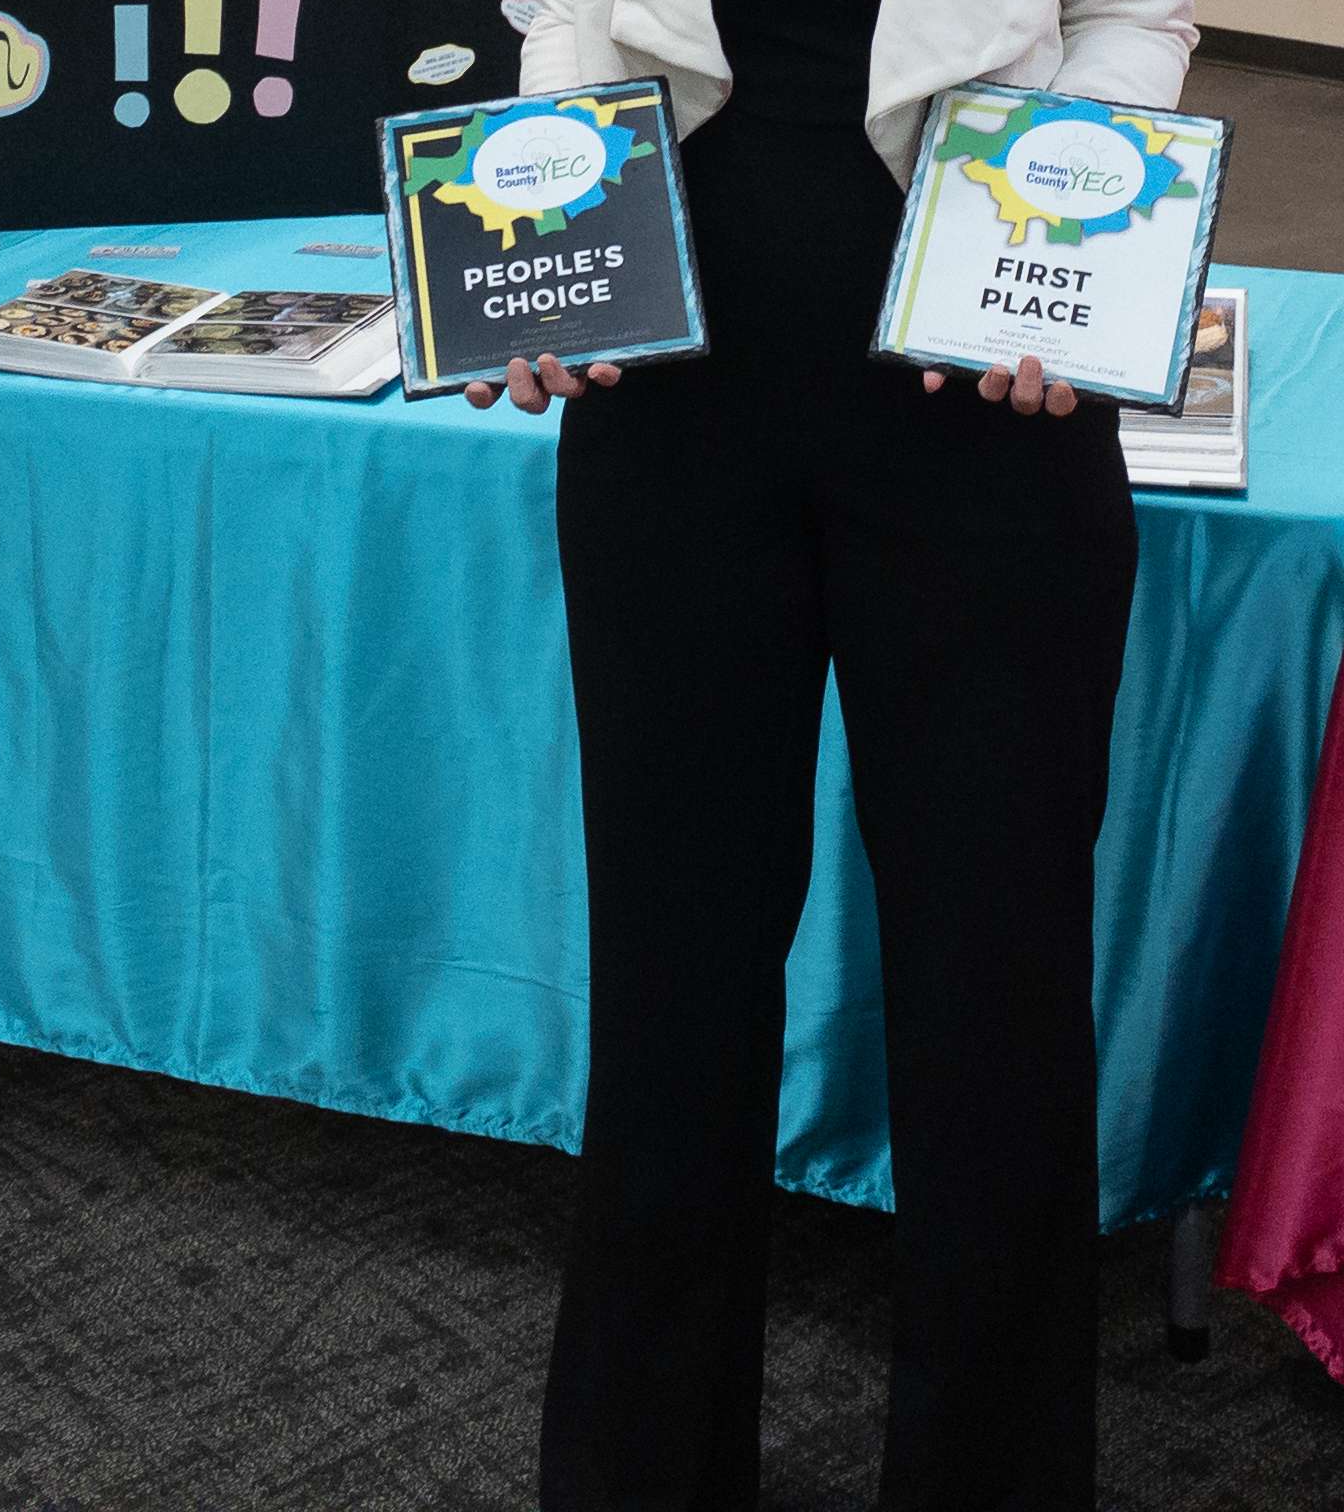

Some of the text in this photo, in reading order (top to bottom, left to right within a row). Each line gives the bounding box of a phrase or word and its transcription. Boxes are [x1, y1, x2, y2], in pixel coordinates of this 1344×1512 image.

[496, 154, 591, 183] Barton YEC
[497, 175, 538, 189] County
[1026, 173, 1068, 192] County
[1028, 161, 1125, 196] Barton YEC
[463, 245, 624, 291] PEOPLE'S
[993, 257, 1092, 293] FIRST
[483, 278, 612, 319] CHOICE
[980, 288, 1091, 328] PLACE
